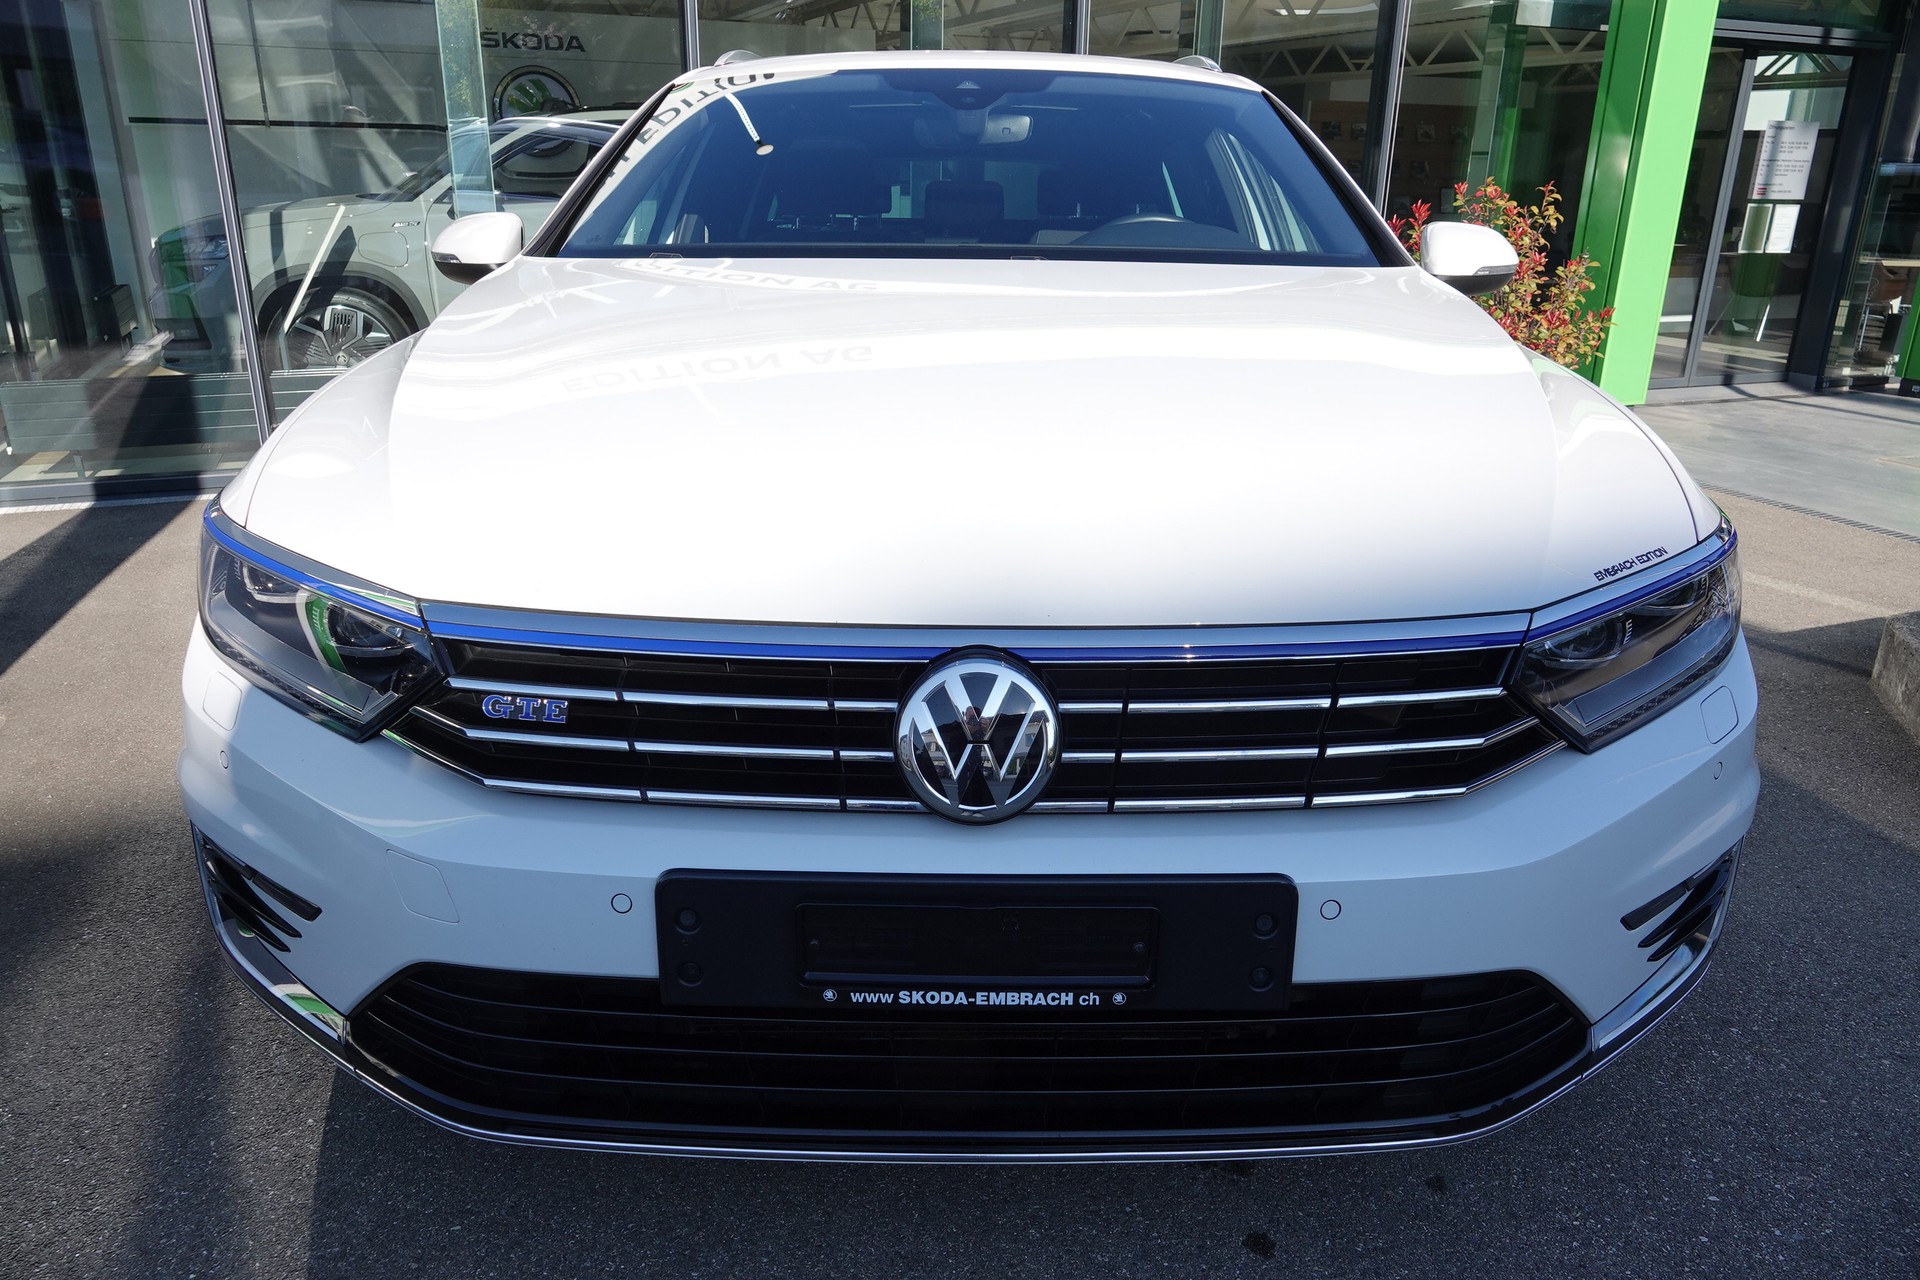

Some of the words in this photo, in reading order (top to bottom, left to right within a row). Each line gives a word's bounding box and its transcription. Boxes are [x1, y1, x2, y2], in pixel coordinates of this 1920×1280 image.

[1593, 558, 1638, 581] EMBRACH
[1635, 546, 1668, 564] EDITION
[482, 694, 568, 724] GTE
[850, 992, 894, 1004] www
[898, 991, 1074, 1006] SKODA-EMBRACH
[1079, 993, 1100, 1006] ch
